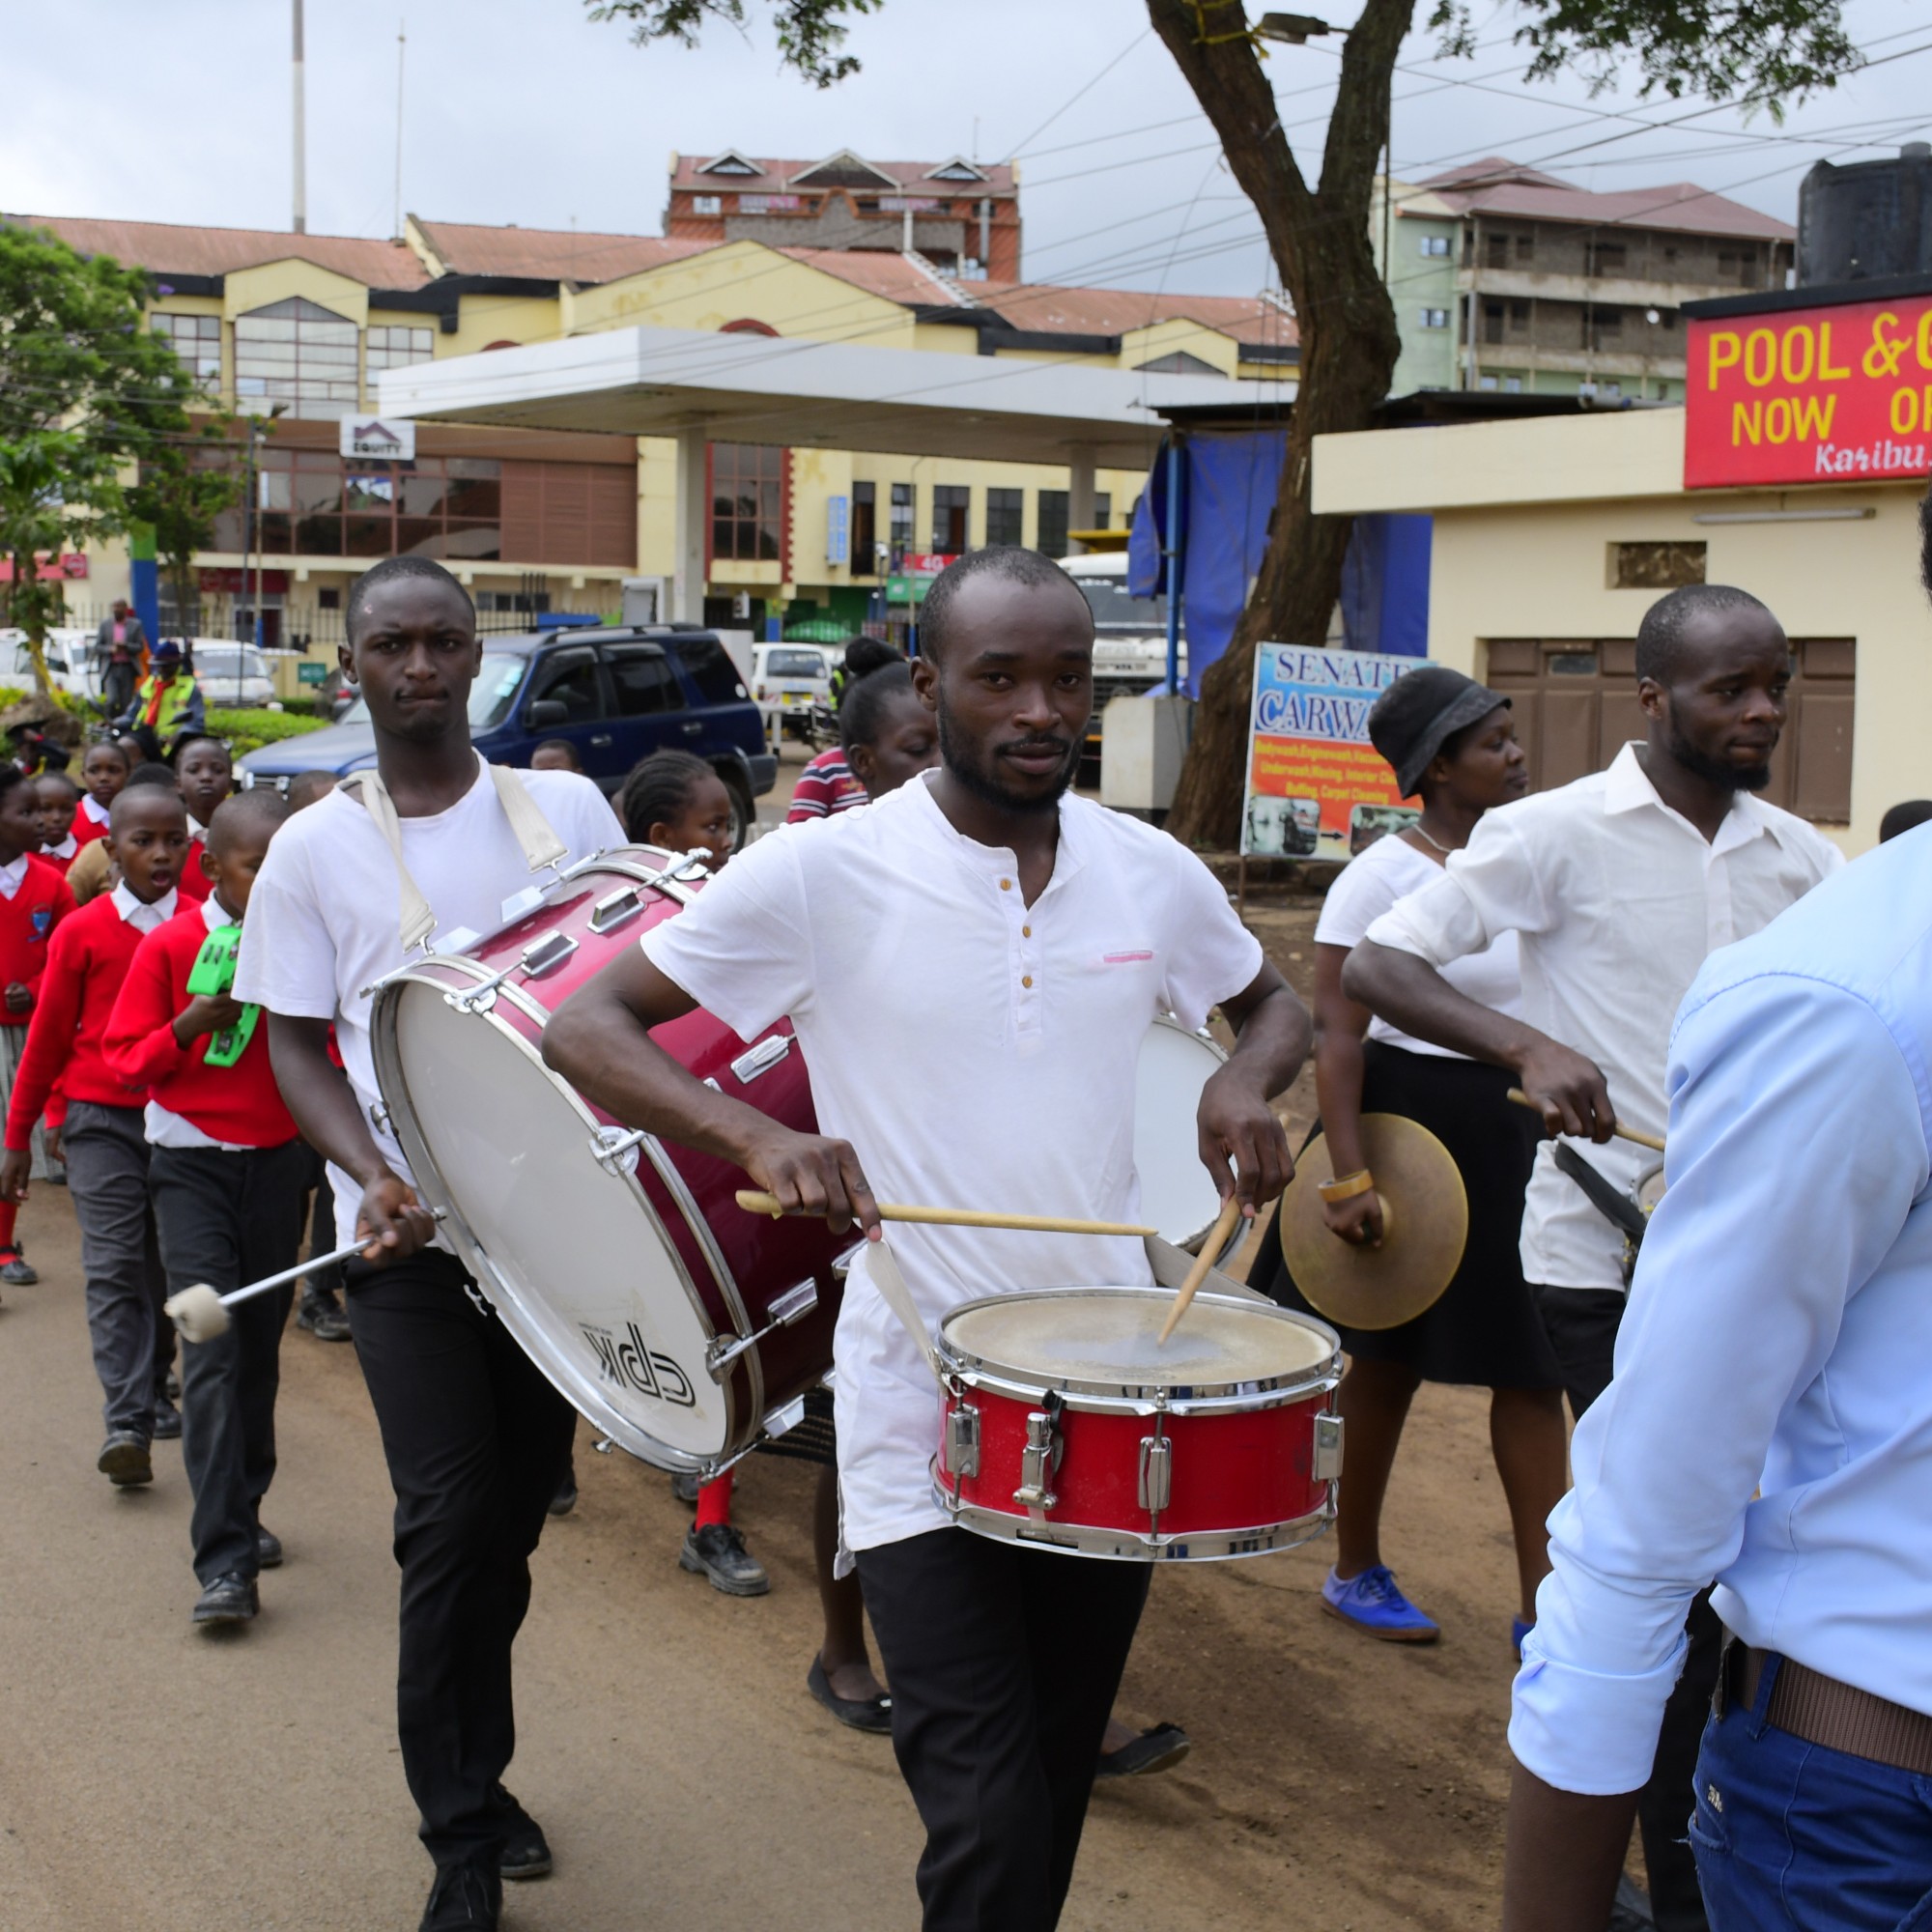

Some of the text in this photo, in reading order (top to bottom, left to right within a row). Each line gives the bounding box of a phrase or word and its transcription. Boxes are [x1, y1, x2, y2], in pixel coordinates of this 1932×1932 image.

[1708, 322, 1851, 391] POOL
[1732, 394, 1836, 446] NOW
[354, 441, 402, 453] EQUITY
